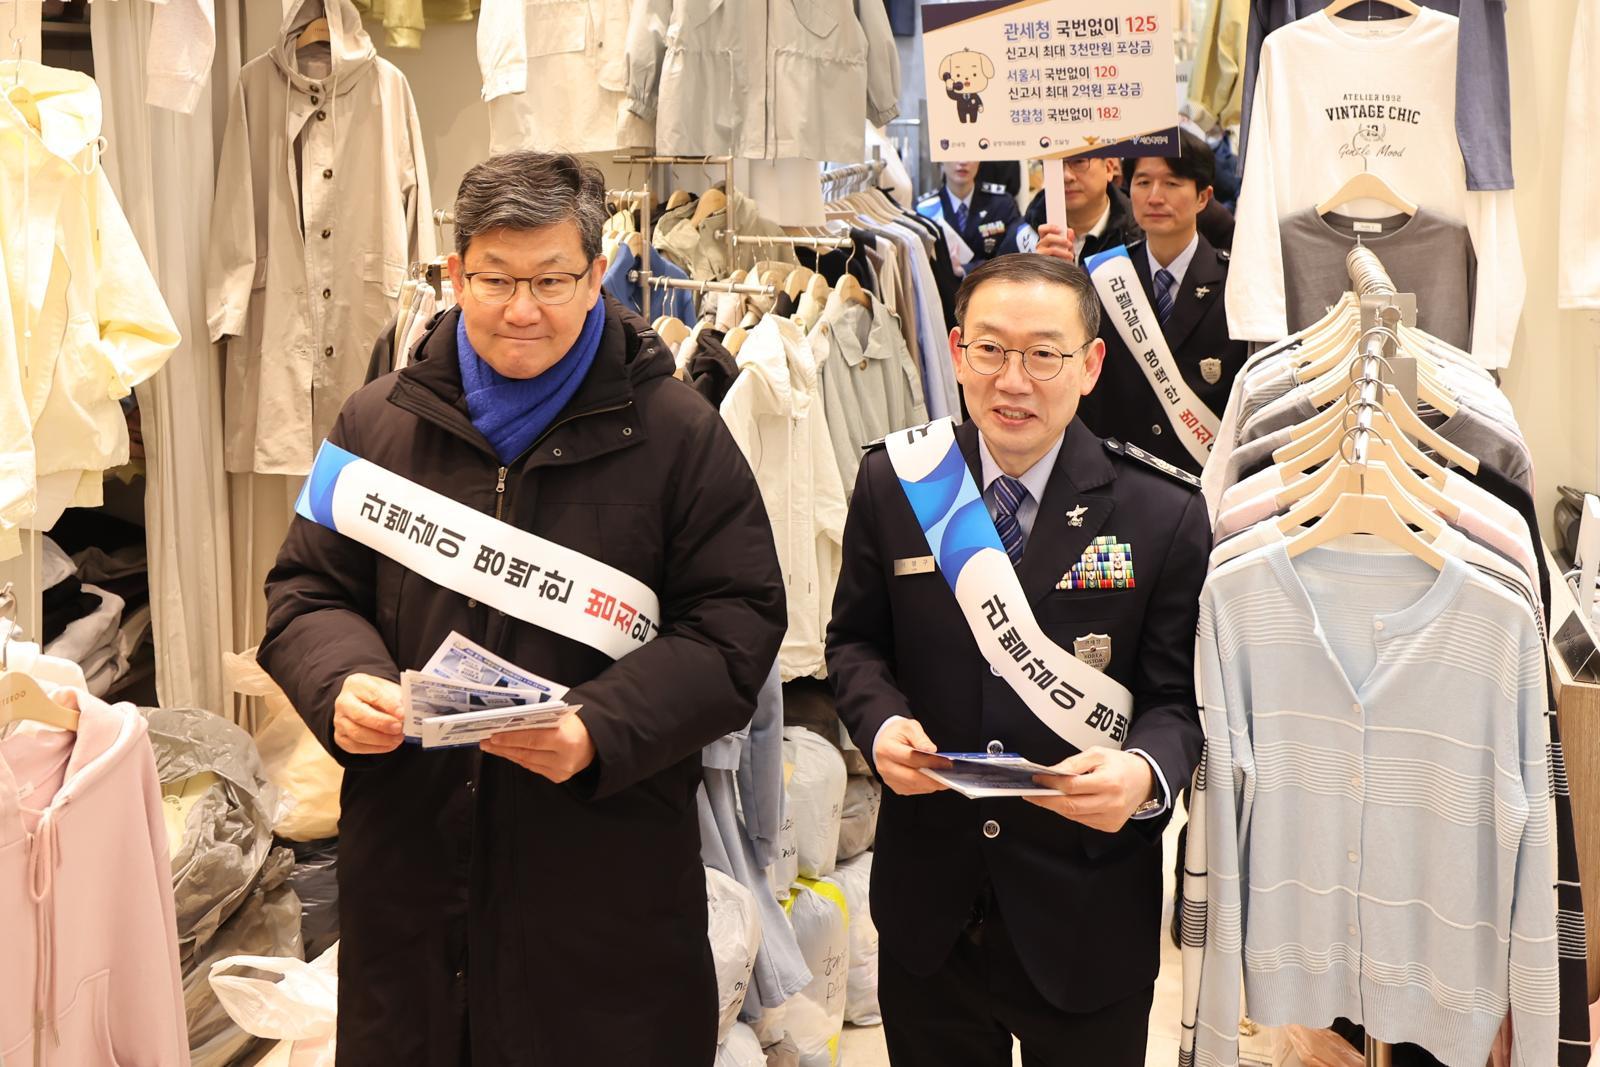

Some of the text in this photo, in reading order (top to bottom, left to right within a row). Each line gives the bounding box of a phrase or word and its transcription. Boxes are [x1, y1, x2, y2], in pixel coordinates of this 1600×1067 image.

[1004, 15, 1157, 41] 관세청 국번없이 125
[1006, 40, 1152, 60] 신고시 최대 3천만원 포상금
[1007, 66, 1117, 82] 서울시 국번없이 120
[1008, 82, 1141, 100] 신고시 최대 2억원 포상금
[1343, 93, 1402, 102] ATELIER 1992
[1010, 107, 1119, 123] 경찰청 국번없이 182
[1325, 105, 1421, 125] VINTAGE CHIC
[1376, 144, 1407, 157] Mood
[1109, 276, 1147, 343] 라벨갈이
[1143, 348, 1181, 405] 명백한
[360, 492, 466, 559] 라벨갈이
[473, 544, 575, 604] 명백한
[981, 594, 1085, 710] 라벨갈이
